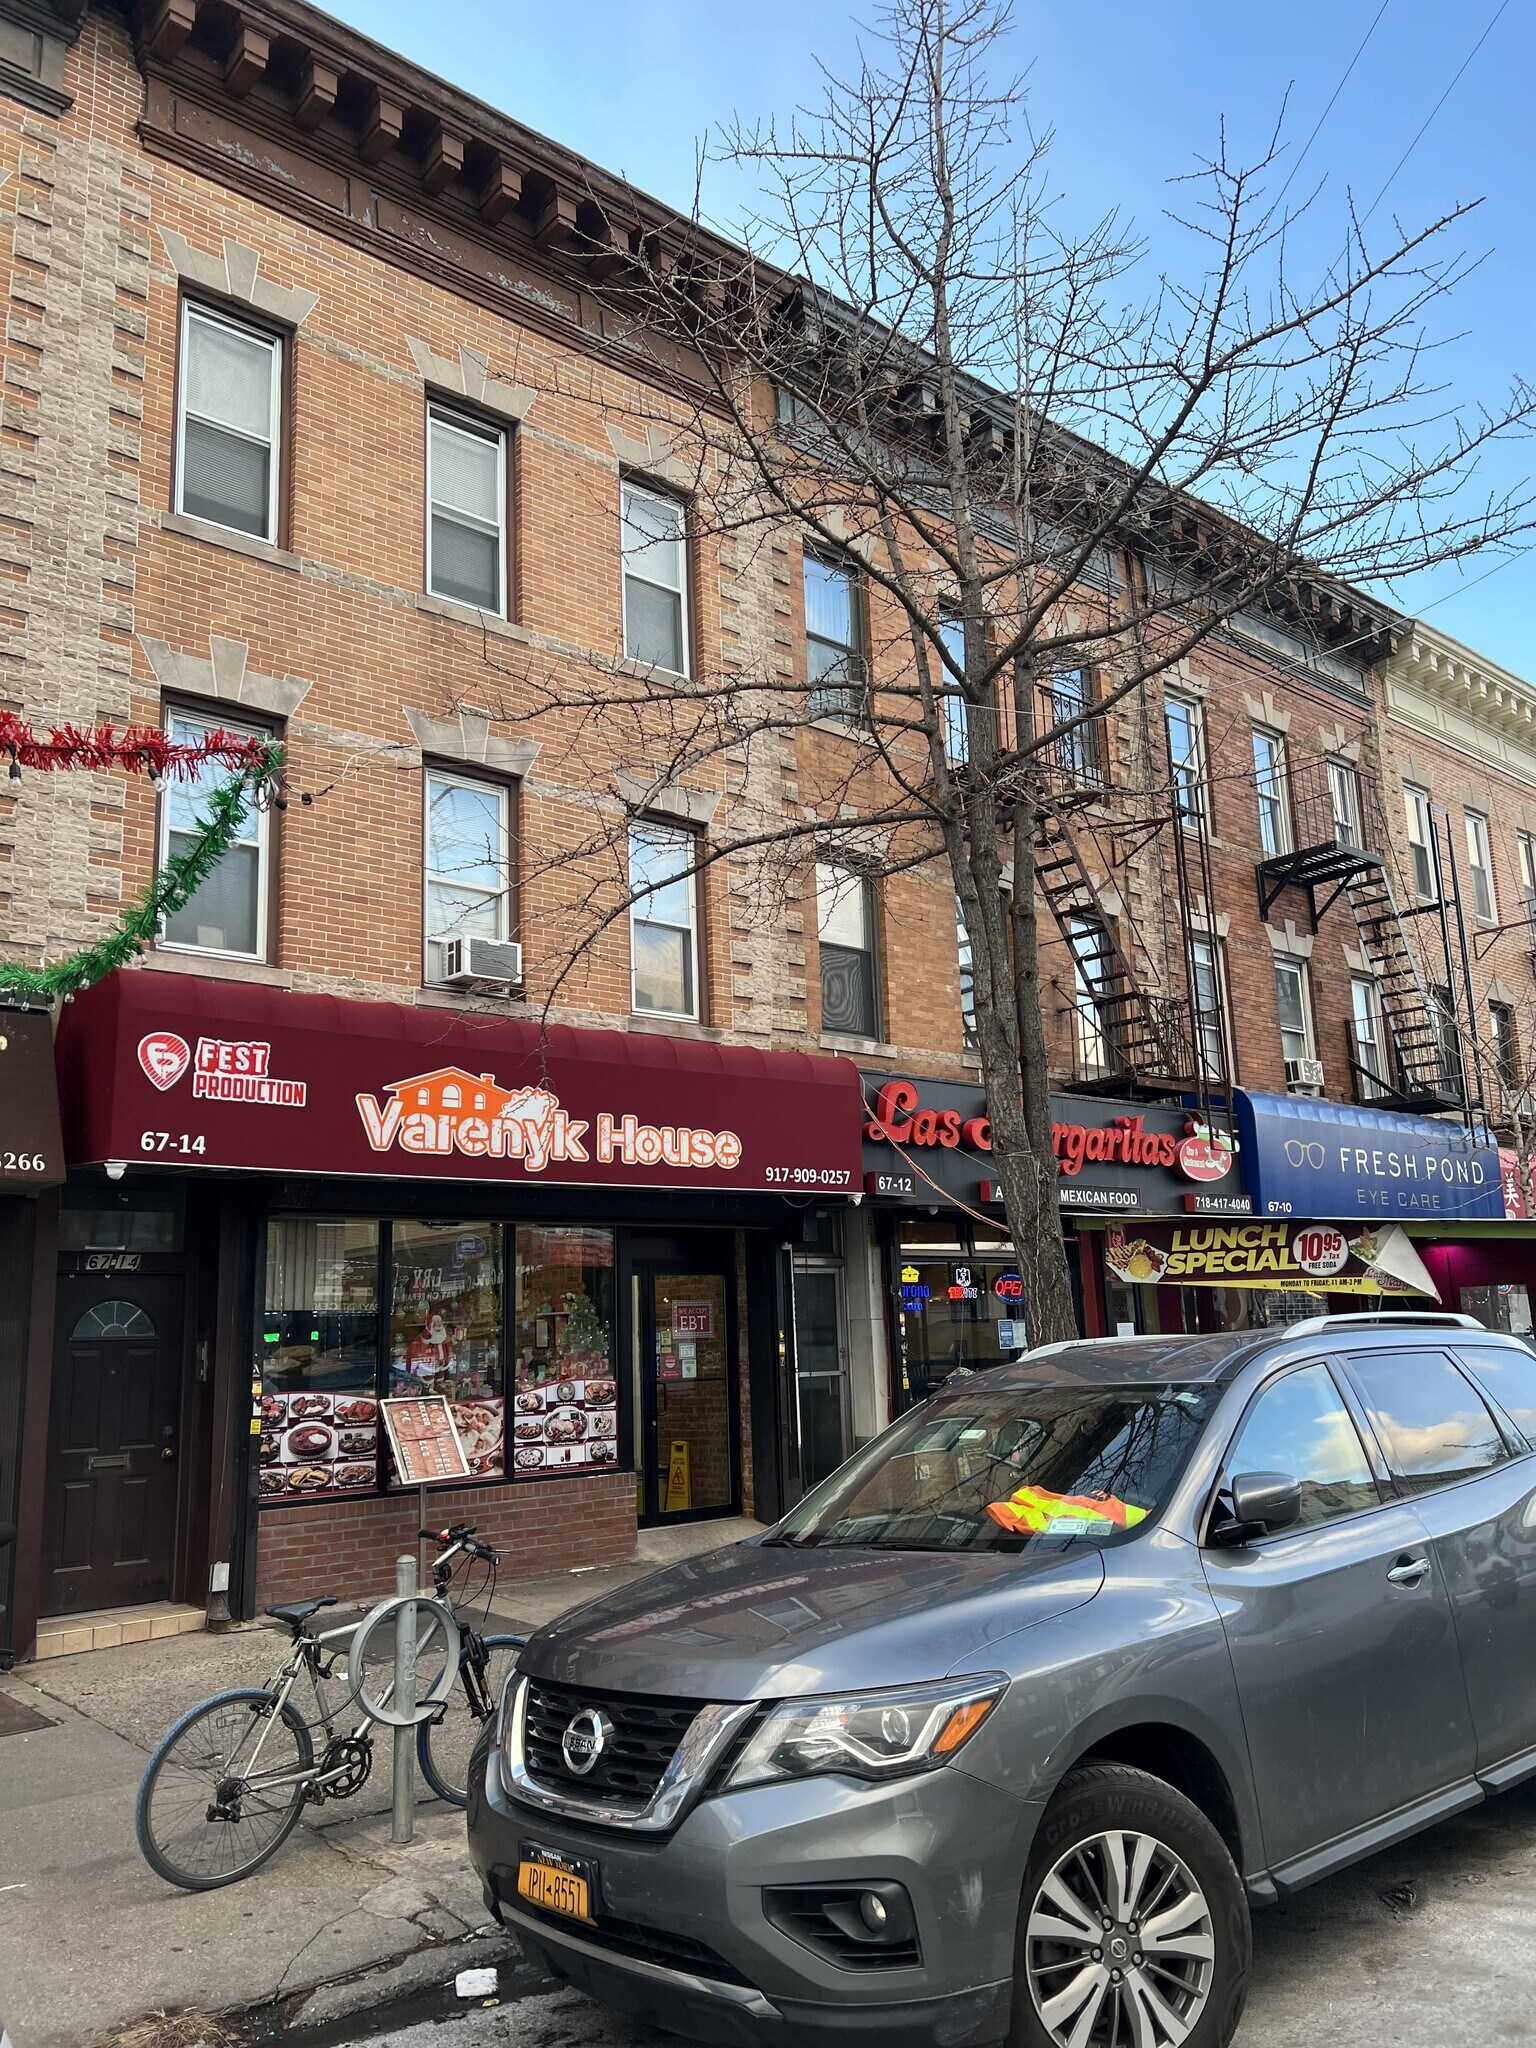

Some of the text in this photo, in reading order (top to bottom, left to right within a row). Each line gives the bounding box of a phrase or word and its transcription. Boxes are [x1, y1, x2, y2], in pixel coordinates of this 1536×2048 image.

[201, 1043, 266, 1073] FEST
[195, 1074, 305, 1105] PRODUCTION
[356, 1092, 743, 1172] Varenyk House
[862, 1080, 1176, 1176] Las rgaritas
[140, 1131, 206, 1155] 67-14
[765, 1166, 851, 1185] 917-909-0257
[1339, 1147, 1485, 1185] FRESH POND
[878, 1175, 912, 1192] 67-12
[1060, 1189, 1138, 1206] MEXICAN FOOD
[1195, 1196, 1250, 1210] 718-417-4040
[1268, 1201, 1293, 1213] 67-10
[1357, 1188, 1442, 1209] EYE CARE
[1171, 1223, 1289, 1251] LUNCH
[88, 1254, 141, 1270] 67-14
[1165, 1247, 1301, 1275] SPECIAL
[1308, 1261, 1337, 1270] FREE SODA
[679, 1315, 707, 1331] EBT
[536, 1854, 554, 1867] NEW
